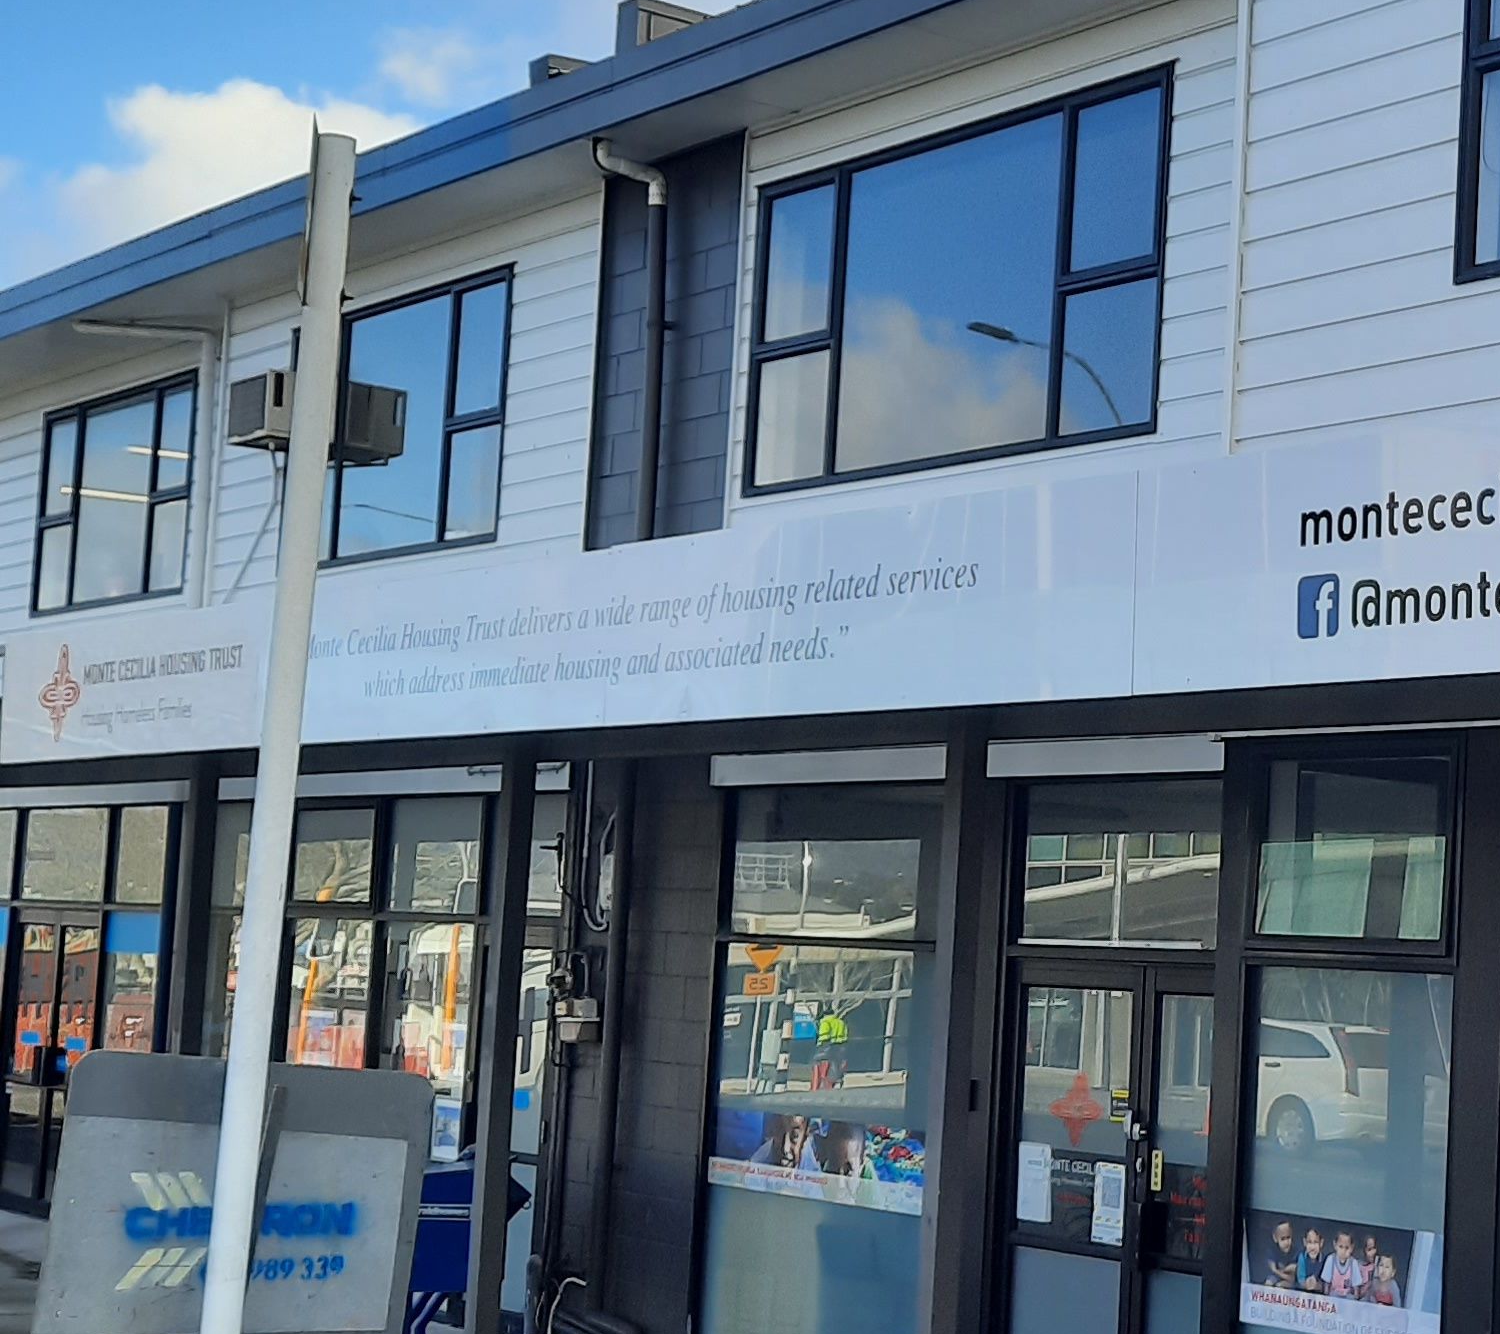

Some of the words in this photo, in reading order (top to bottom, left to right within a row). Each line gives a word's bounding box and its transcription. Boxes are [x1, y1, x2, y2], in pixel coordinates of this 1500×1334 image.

[347, 625, 397, 656] Cecilia
[400, 619, 462, 653] Housing
[466, 614, 507, 644] Trust
[508, 606, 573, 638] delivers
[577, 608, 589, 630] a
[594, 595, 635, 627] wide
[640, 596, 693, 628] range
[697, 583, 719, 624] of
[719, 577, 798, 616] housing
[804, 563, 882, 605] related
[886, 557, 979, 597] services
[83, 660, 116, 685] MONTE
[118, 655, 156, 681] CECILIA
[159, 650, 206, 677] HOUSING
[209, 644, 244, 670] TRUST
[364, 669, 405, 698] which
[409, 666, 465, 695] address
[469, 656, 549, 691] immediate
[553, 649, 622, 686] housing
[627, 642, 662, 676] and
[664, 632, 765, 673] associated
[124, 1202, 355, 1239] CHERON
